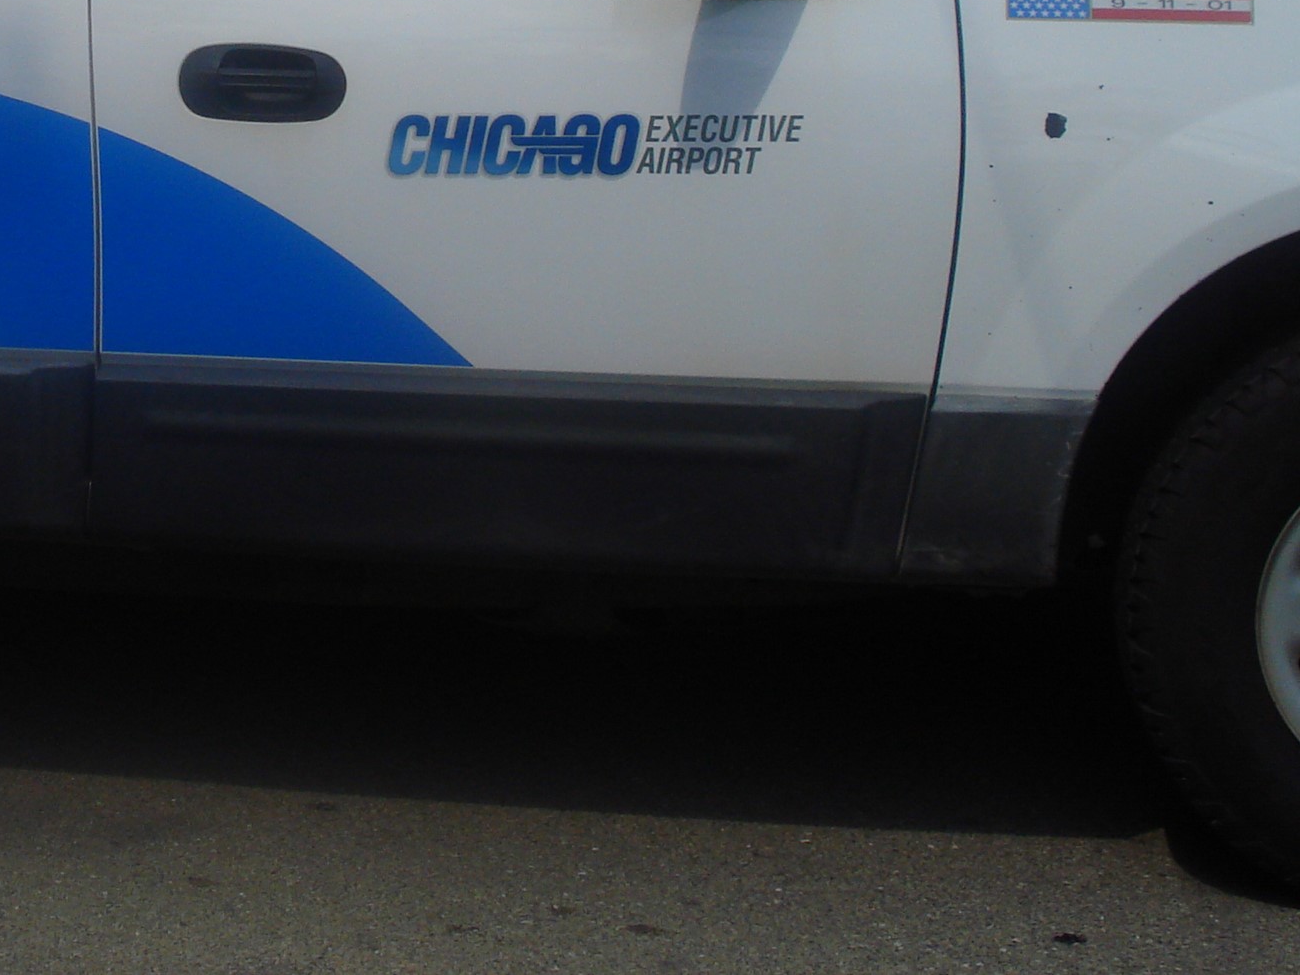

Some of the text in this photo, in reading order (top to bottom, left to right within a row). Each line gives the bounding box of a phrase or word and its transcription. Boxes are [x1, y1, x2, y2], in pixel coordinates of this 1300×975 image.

[388, 113, 804, 176] CHICAGO EXECUTIVE
[637, 147, 762, 175] AIRPORT
